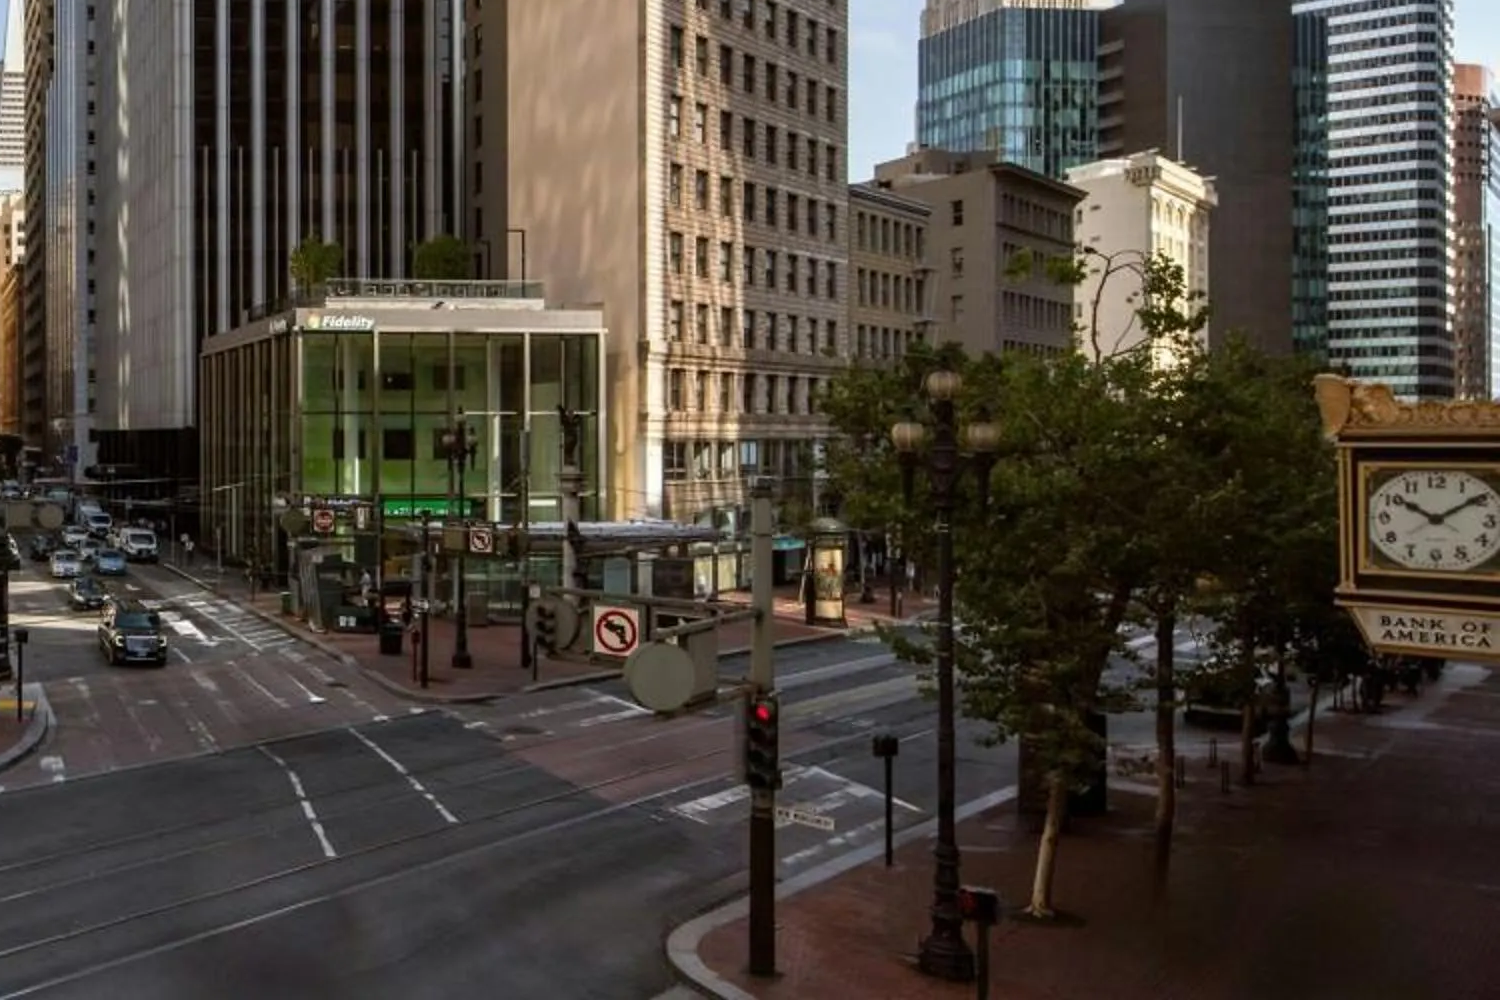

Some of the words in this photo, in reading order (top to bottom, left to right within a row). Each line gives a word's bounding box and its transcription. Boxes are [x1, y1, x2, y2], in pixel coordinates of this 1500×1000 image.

[322, 314, 375, 330] Fidelity
[1405, 481, 1418, 494] 11
[1427, 475, 1446, 489] 12
[1459, 481, 1465, 494] 1
[1482, 514, 1496, 529] 3
[1474, 533, 1488, 548] 4
[1454, 545, 1467, 560] 5
[1381, 615, 1444, 630] BANK
[1461, 621, 1491, 634] OF
[1382, 629, 1491, 648] AMERICA
